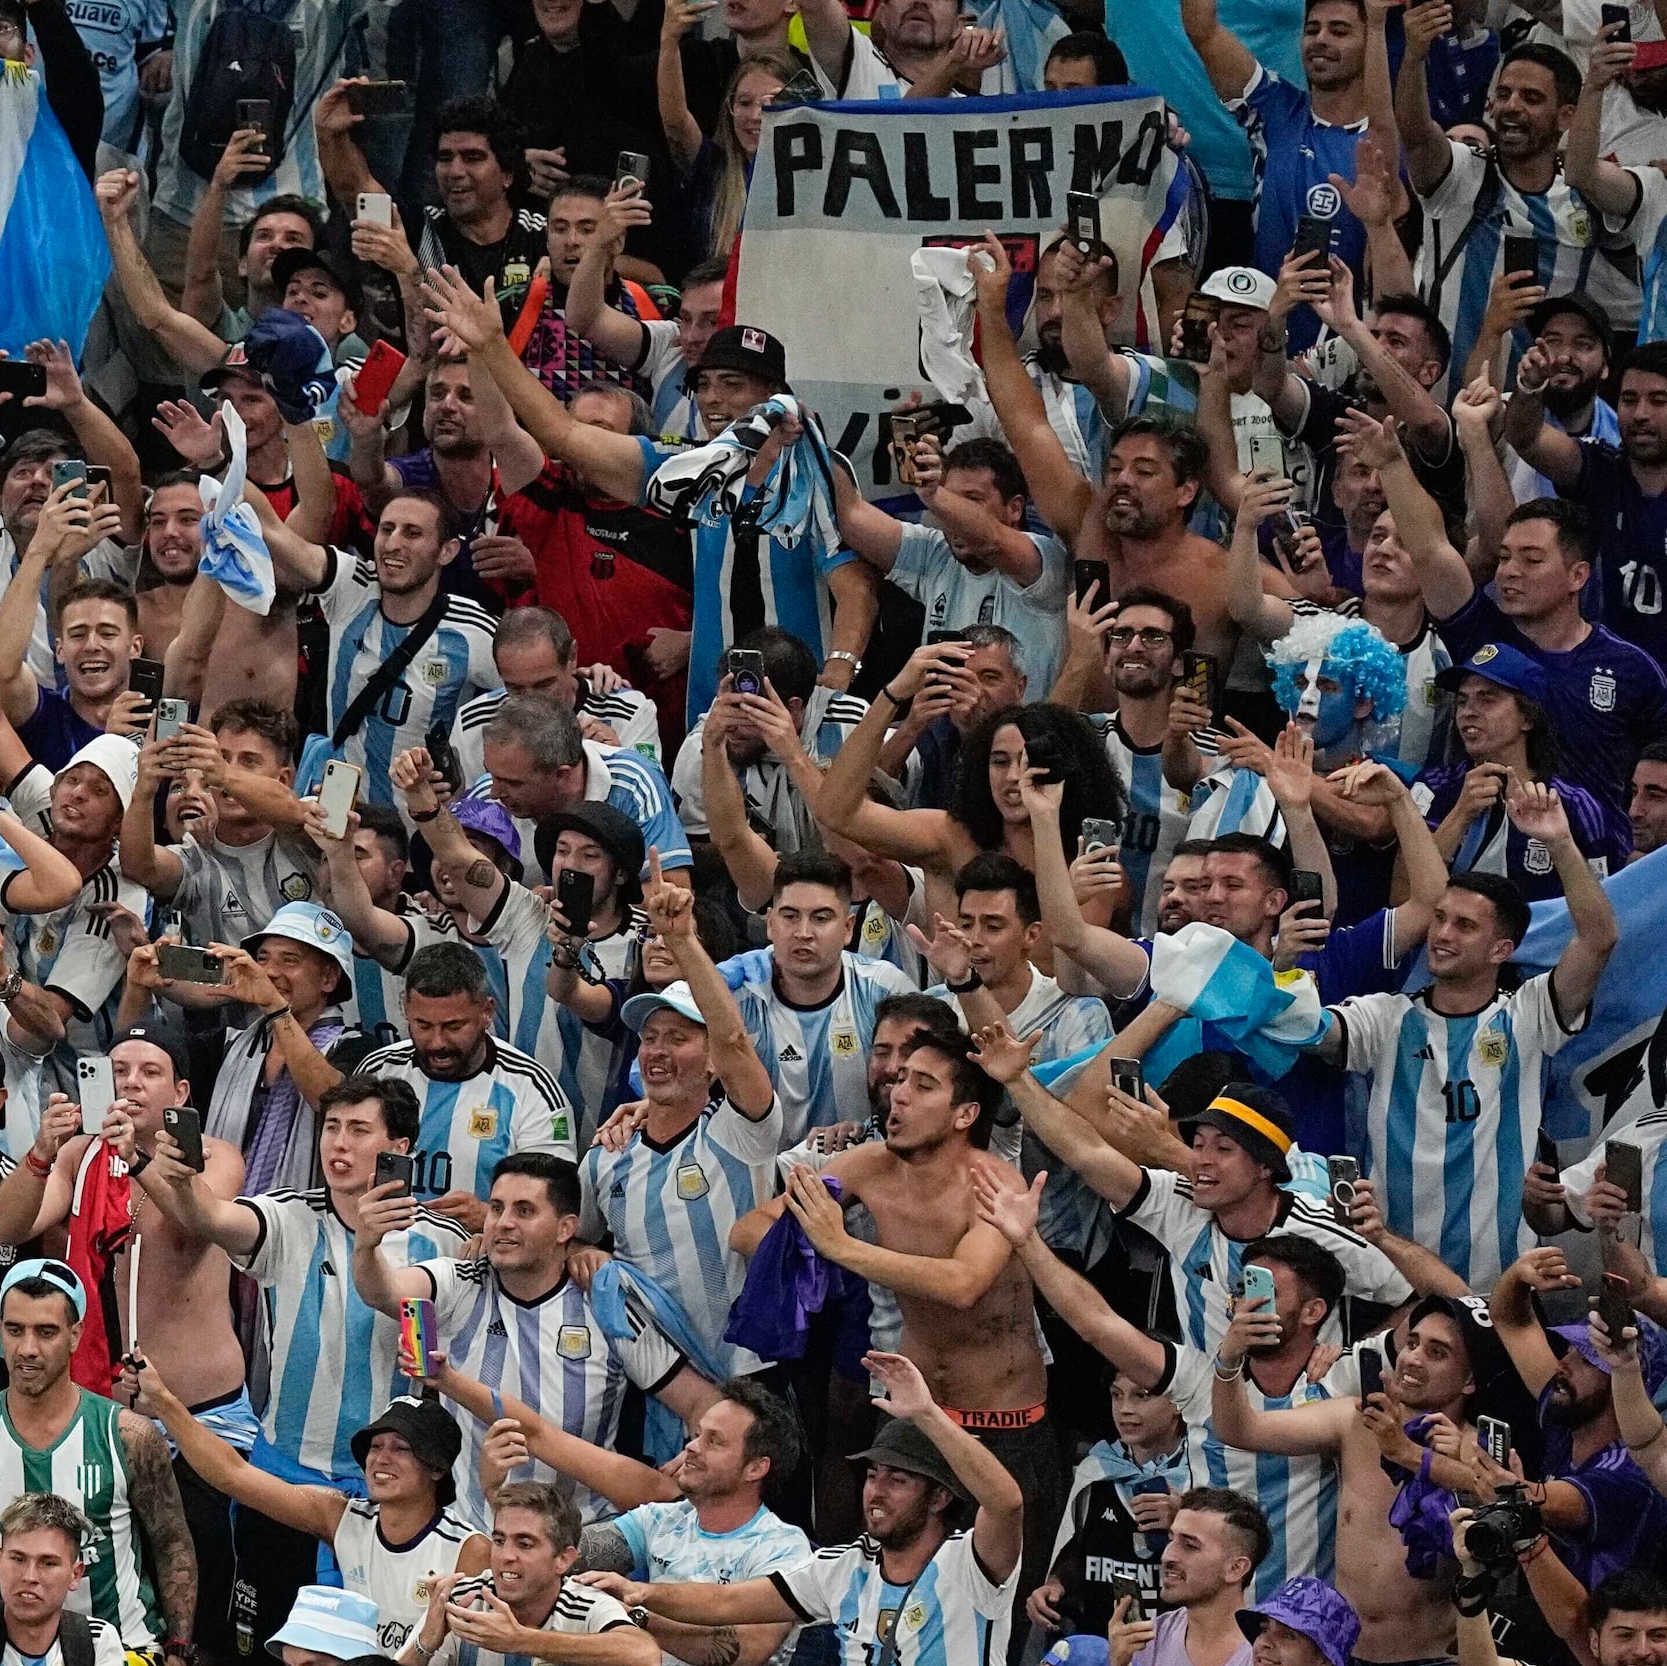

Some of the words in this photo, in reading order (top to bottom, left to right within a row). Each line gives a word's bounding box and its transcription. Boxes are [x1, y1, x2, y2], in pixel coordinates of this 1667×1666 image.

[772, 108, 1166, 223] PALERMO
[1618, 560, 1662, 614] 10
[1440, 1079, 1481, 1123] 10
[410, 1150, 454, 1195] 10
